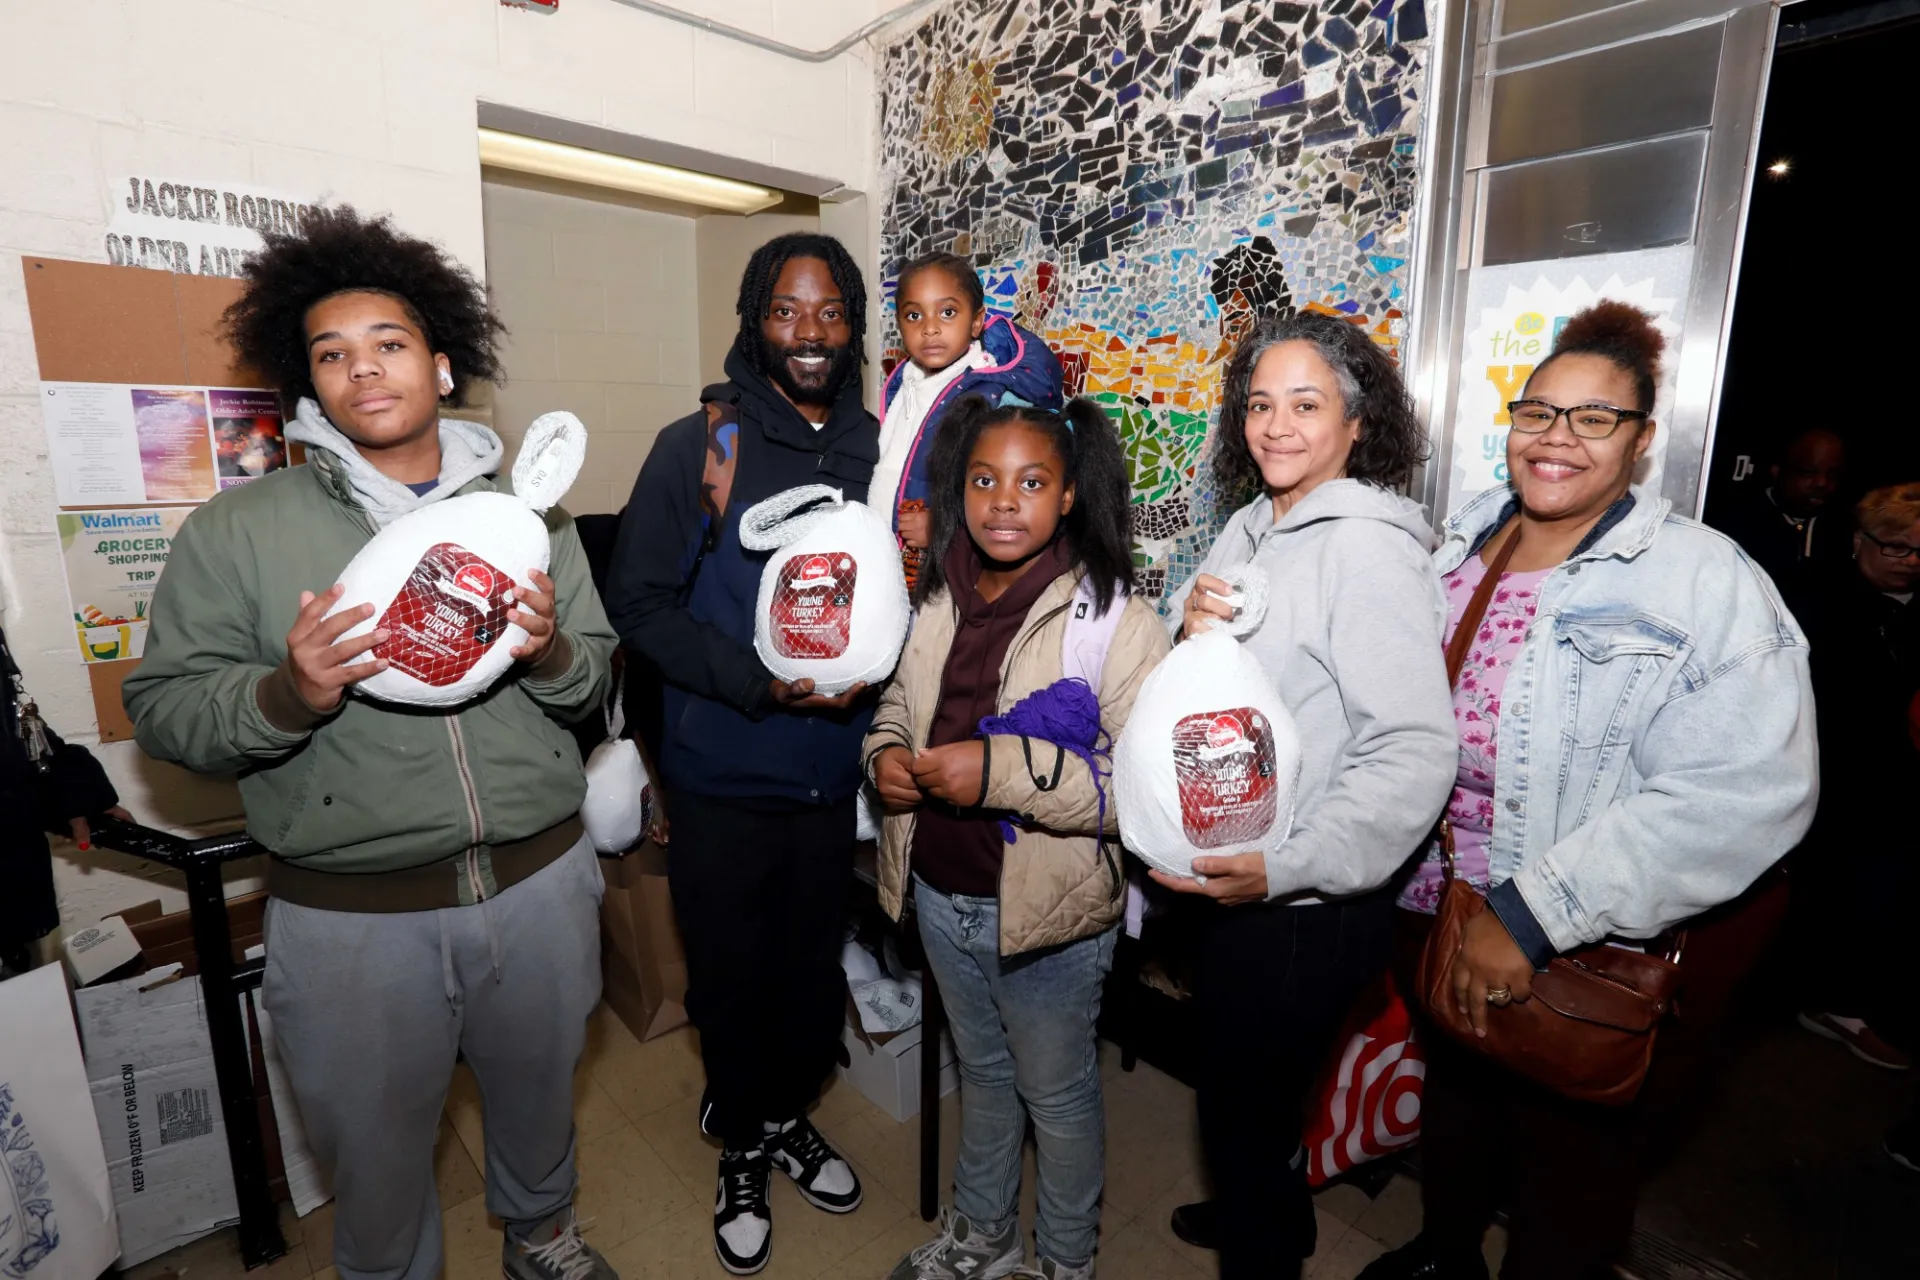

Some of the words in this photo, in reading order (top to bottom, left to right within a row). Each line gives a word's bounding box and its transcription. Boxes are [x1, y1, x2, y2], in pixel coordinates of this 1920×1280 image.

[126, 177, 220, 225] JACKIE
[223, 191, 336, 241] ROBINS
[106, 232, 193, 275] OLDER
[1519, 315, 1542, 332] Be
[1490, 330, 1541, 358] the
[220, 398, 241, 406] Jackie
[80, 512, 161, 528] Walmart
[108, 553, 170, 565] SHOPPING
[126, 570, 156, 581] TRIP
[797, 594, 825, 606] YOUNG
[434, 601, 469, 628] YOUNG
[791, 607, 825, 618] TURKEY
[421, 612, 463, 640] TURKEY
[1215, 764, 1247, 781] YOUNG
[1212, 780, 1250, 797] TURKEY
[121, 1063, 136, 1097] BELOW
[125, 1097, 138, 1112] OR
[128, 1129, 144, 1168] FROZEN
[132, 1168, 145, 1193] KEEP
[955, 1256, 979, 1274] N
